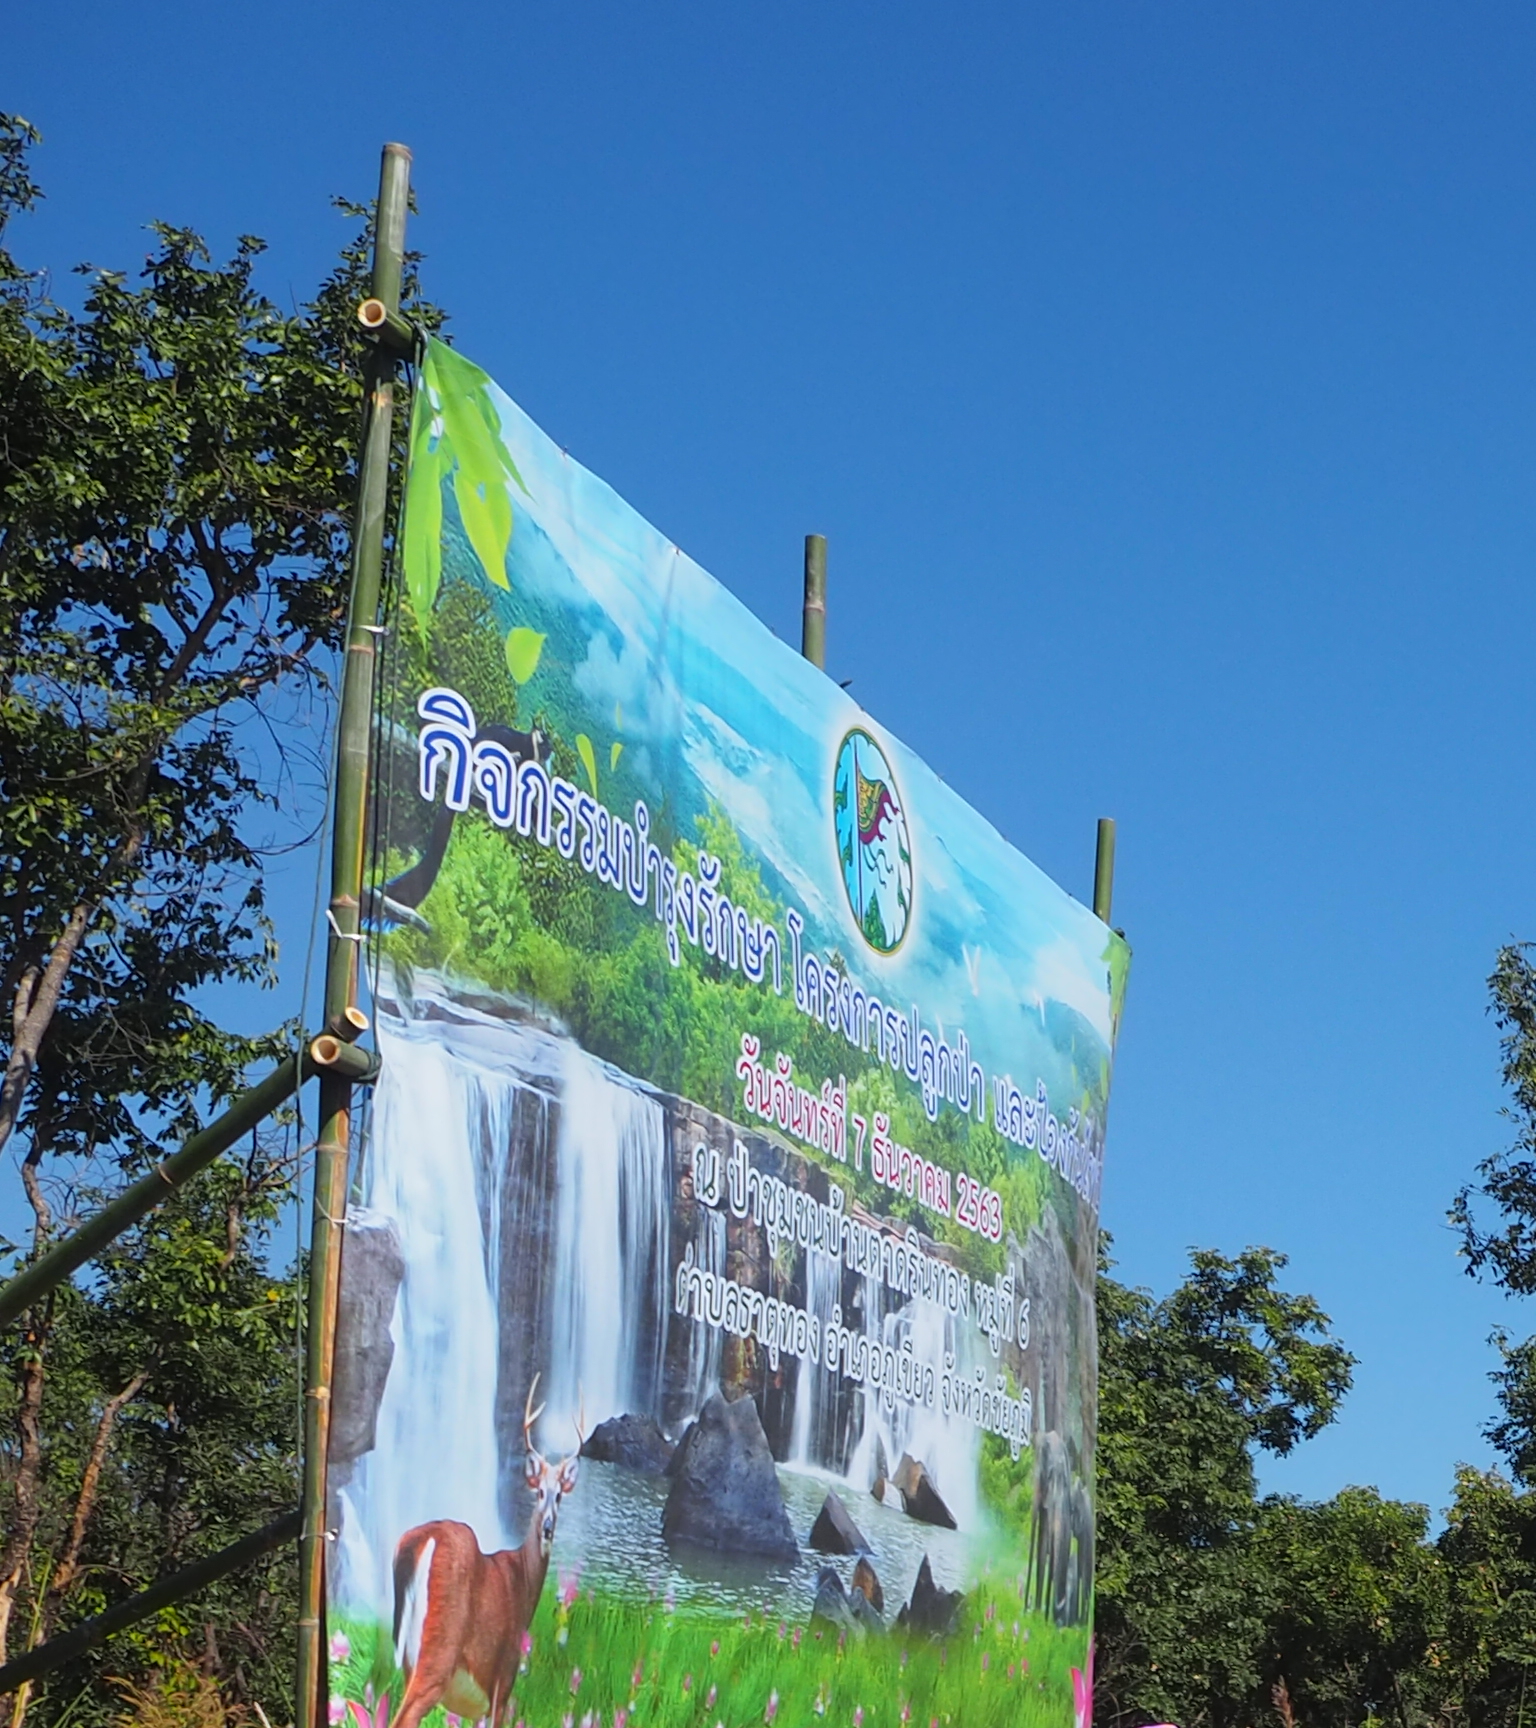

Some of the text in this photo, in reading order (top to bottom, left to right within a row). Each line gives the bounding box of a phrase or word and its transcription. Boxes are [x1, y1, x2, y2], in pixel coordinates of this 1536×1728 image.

[417, 687, 782, 994] กิจกรรมบำรุงรักษา
[789, 912, 985, 1118] โครงการปลูกป่า
[738, 1034, 1002, 1243] วันจันทร์ที่ 7 ธันวาคม 2563
[675, 1242, 1031, 1461] ตำบลธาตุทอง อำเภอภูเขียว จังหวัดชัยภูมิ
[692, 1142, 721, 1206] ณ
[974, 1262, 1015, 1358] หมู่ที่
[1016, 1298, 1031, 1350] 6
